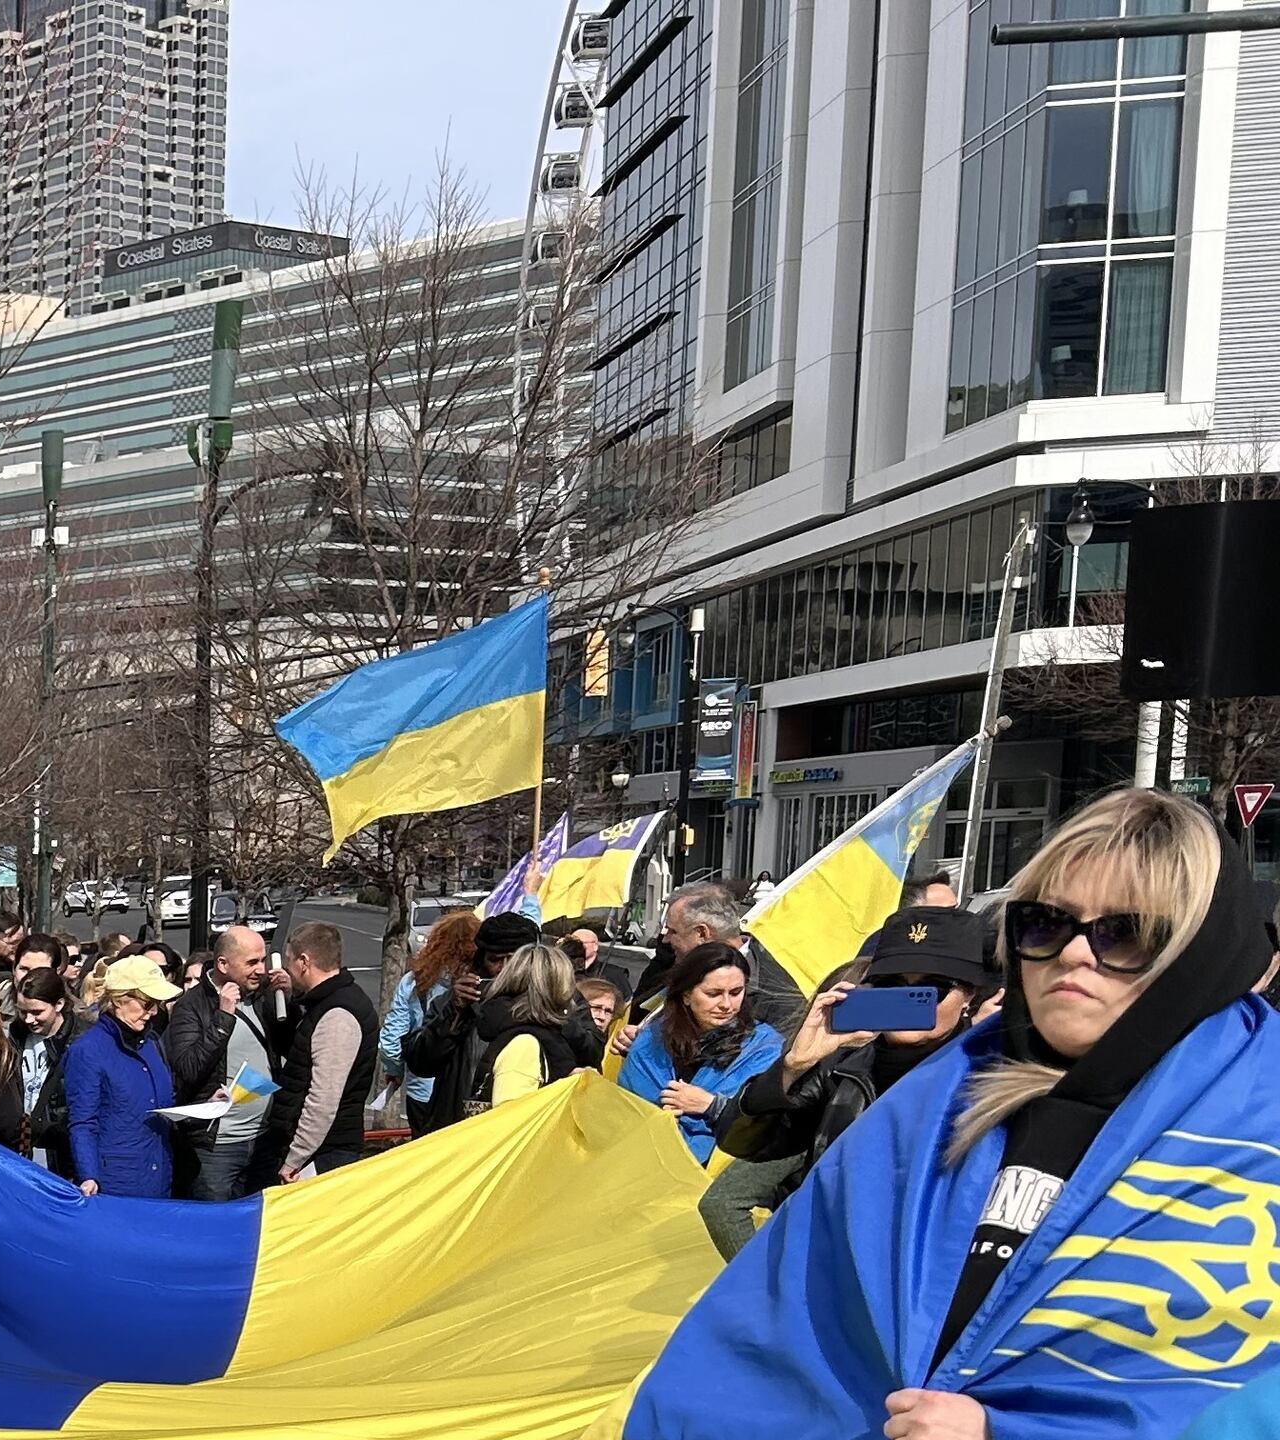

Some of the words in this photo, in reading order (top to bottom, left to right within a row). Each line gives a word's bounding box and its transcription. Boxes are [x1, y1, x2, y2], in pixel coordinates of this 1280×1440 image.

[116, 242, 165, 269] Coastal
[172, 233, 213, 256] States
[254, 231, 292, 251] Coastal
[700, 720, 733, 732] SECO
